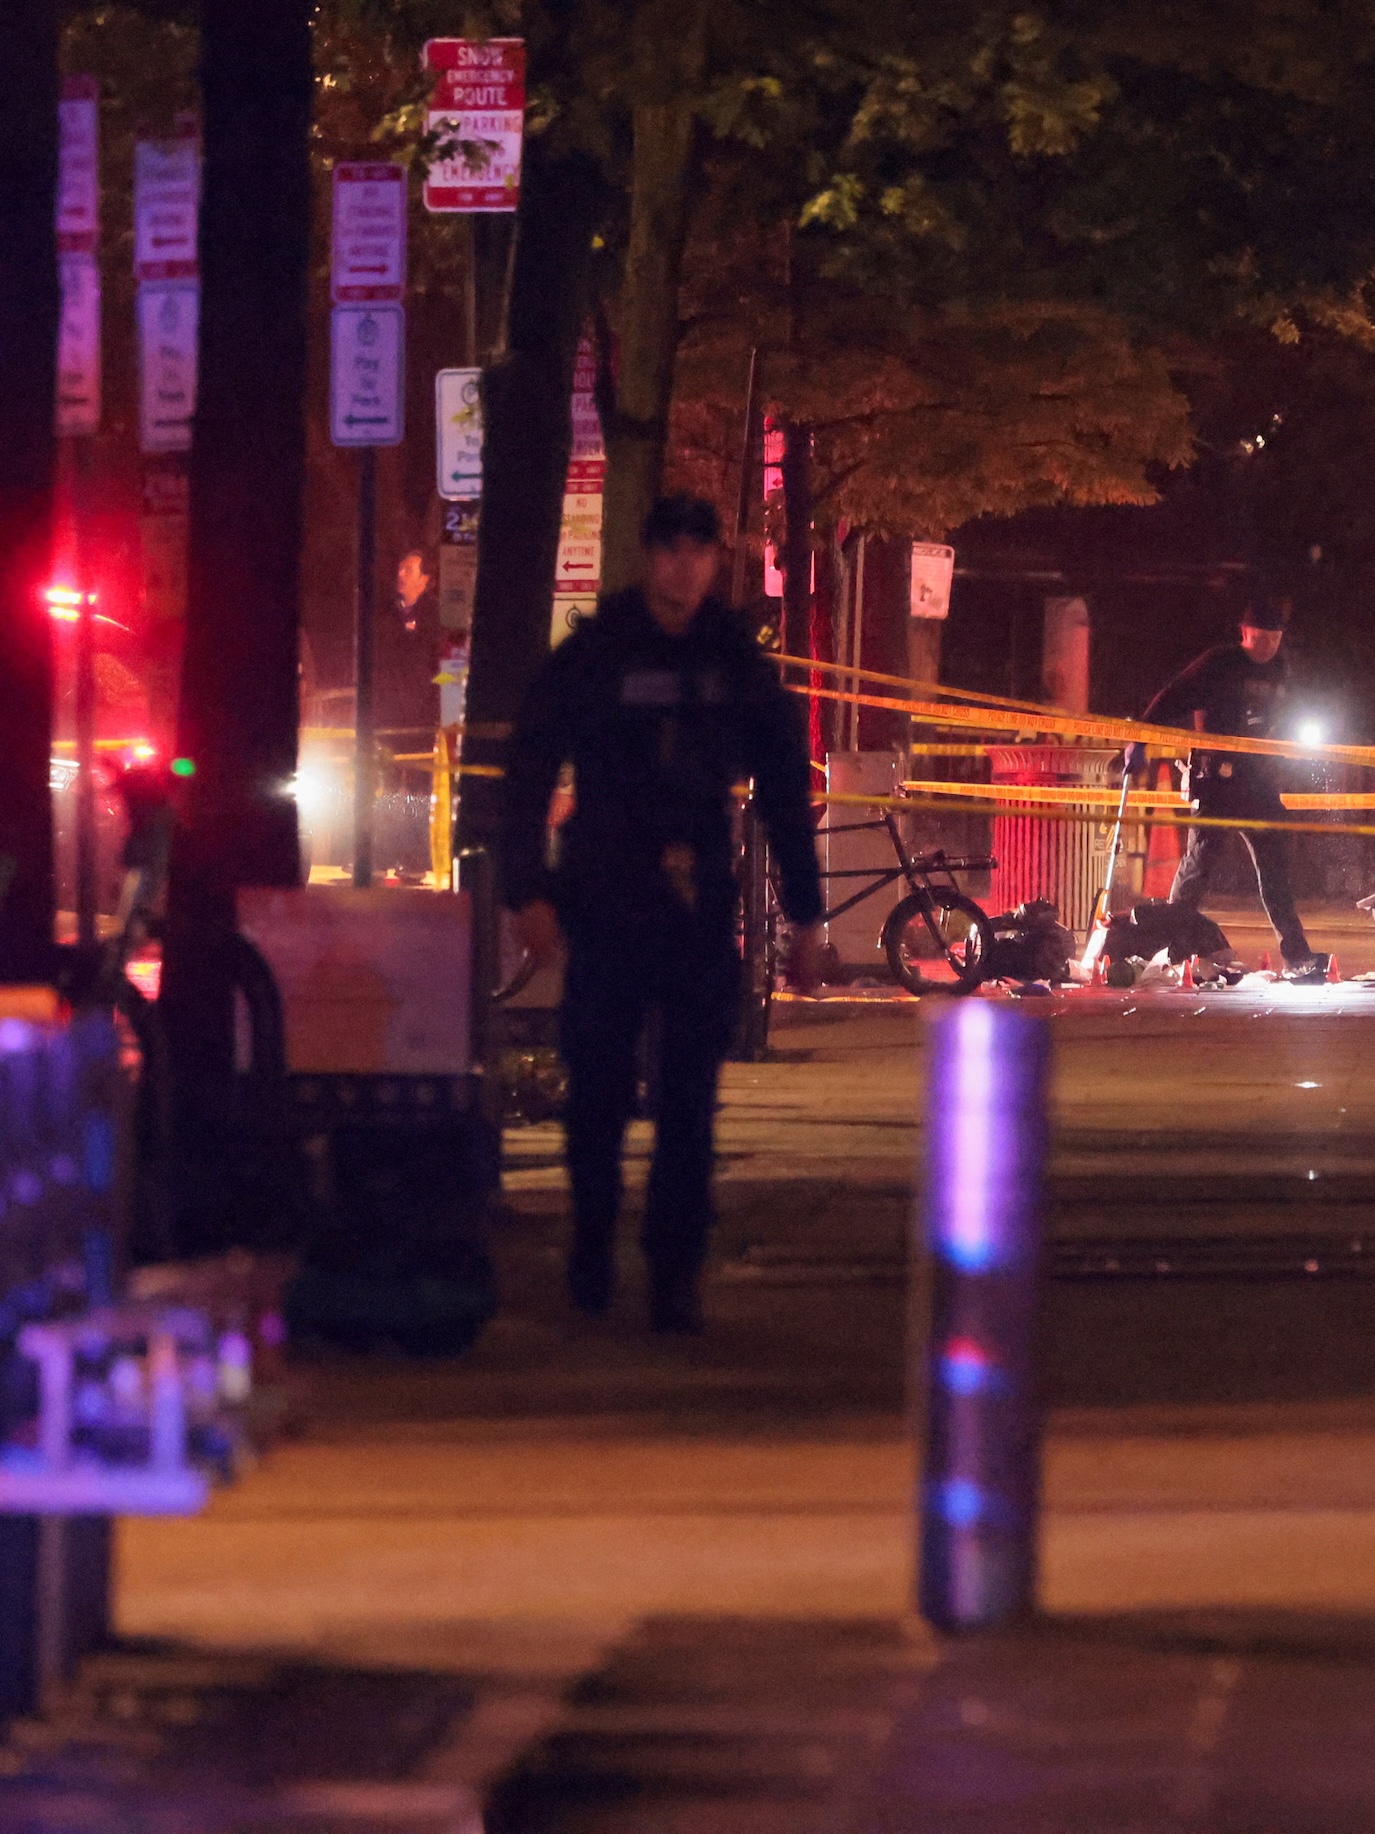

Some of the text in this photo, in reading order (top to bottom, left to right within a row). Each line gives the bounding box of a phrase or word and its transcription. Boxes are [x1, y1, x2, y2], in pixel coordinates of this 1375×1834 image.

[457, 46, 503, 66] SNOW
[447, 70, 514, 83] EMERGENCY
[453, 86, 507, 106] ROUTE
[562, 546, 595, 557] ANYTIME
